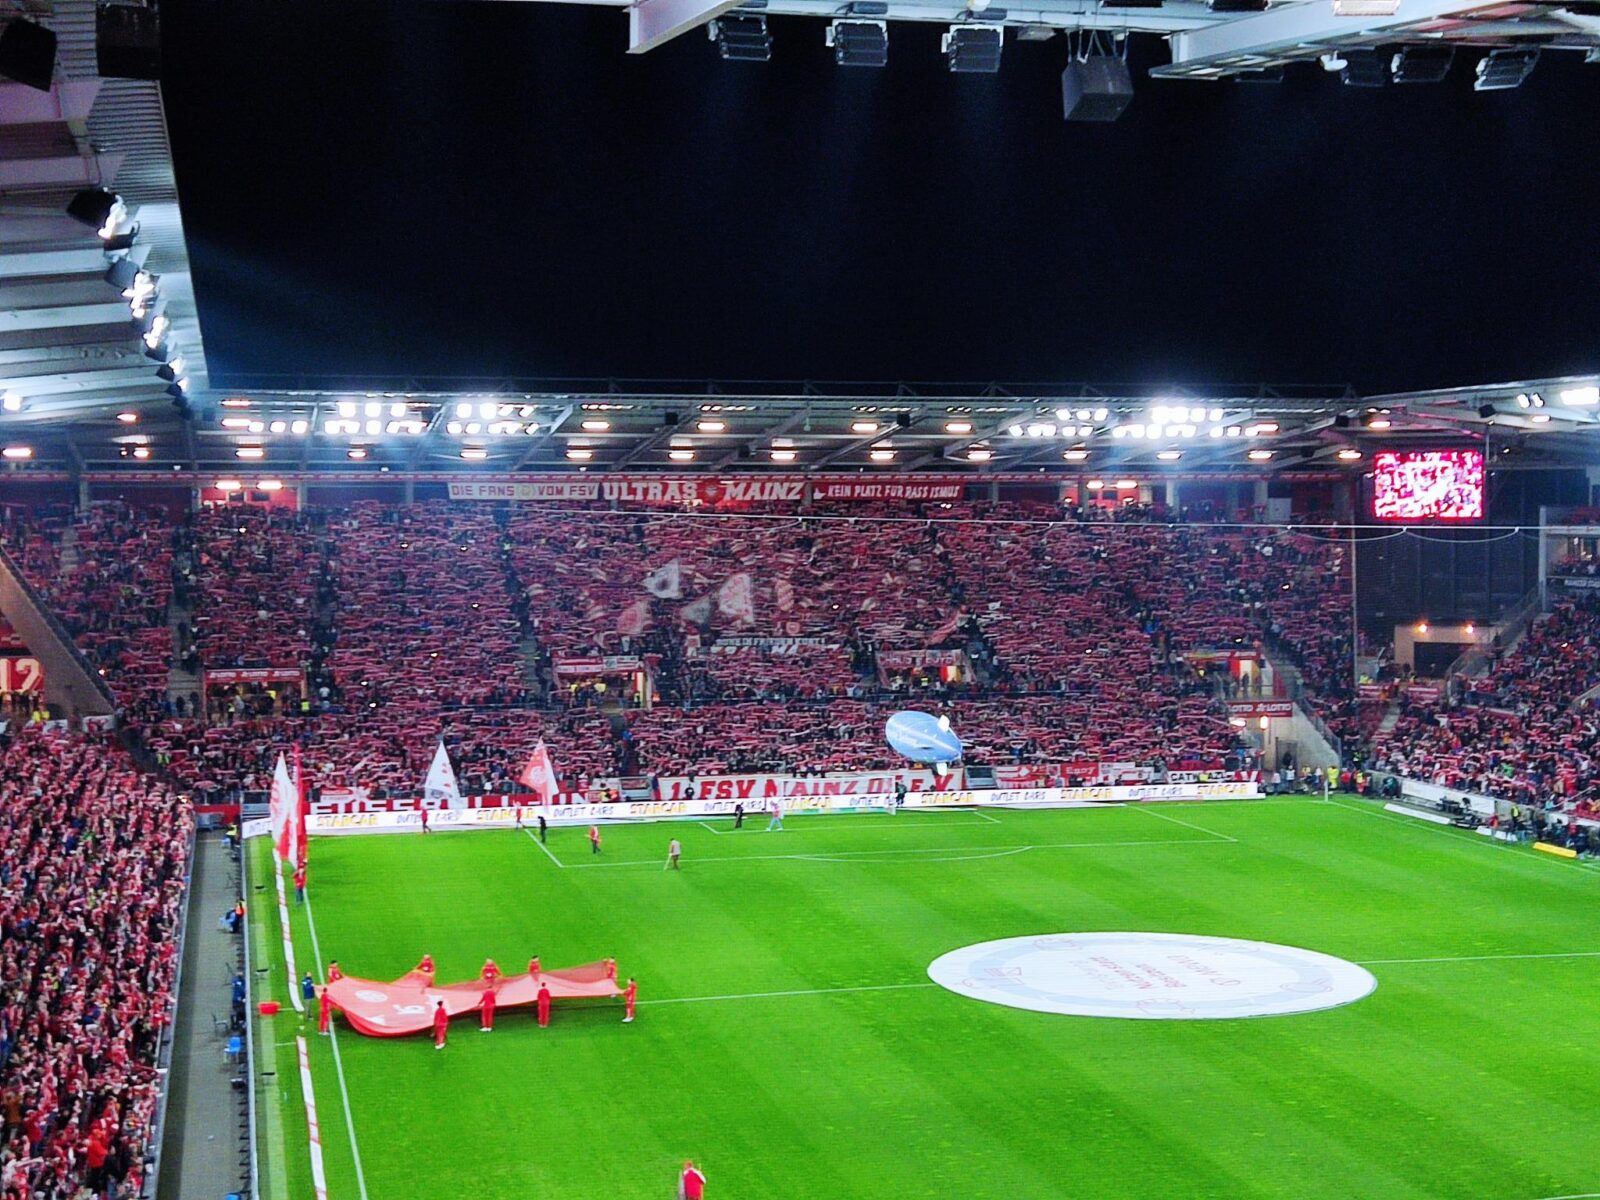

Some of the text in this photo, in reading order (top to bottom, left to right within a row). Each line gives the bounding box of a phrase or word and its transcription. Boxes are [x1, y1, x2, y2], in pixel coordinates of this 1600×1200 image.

[451, 485, 596, 496] DIE FANS VOM FSV
[602, 481, 805, 501] ULTRAS MAINZ
[827, 484, 851, 497] KEIN
[854, 484, 881, 497] PLATZ
[700, 779, 757, 799] FSV
[630, 801, 688, 815] STARCAR
[921, 792, 974, 804] STARCAR
[1060, 788, 1113, 799] STARCAR
[1197, 784, 1249, 795] STARCAR
